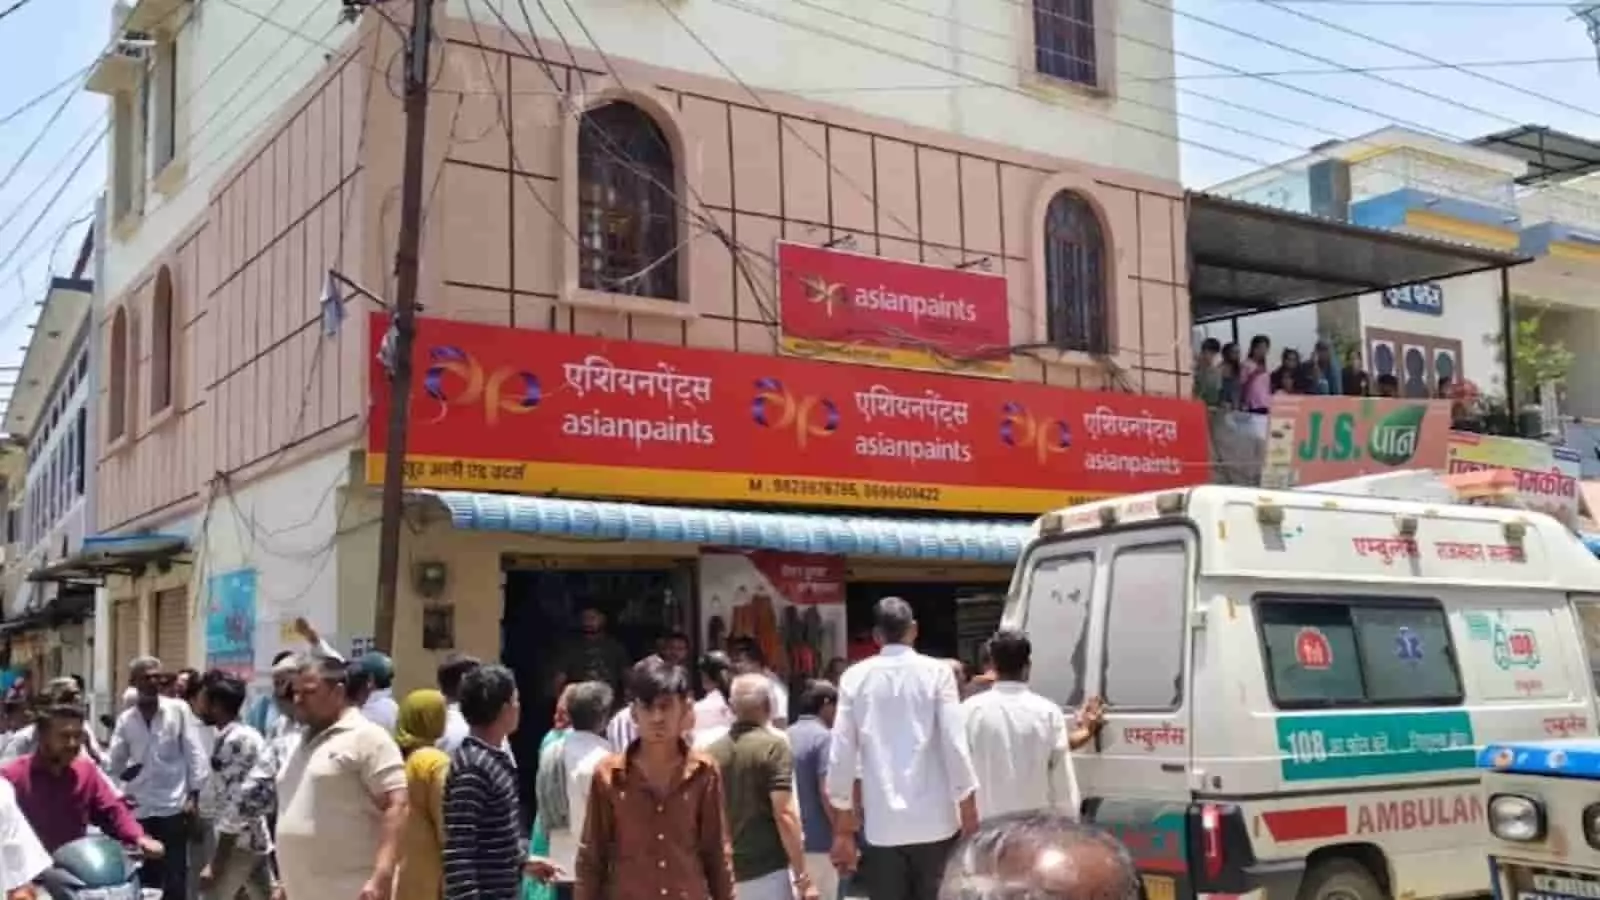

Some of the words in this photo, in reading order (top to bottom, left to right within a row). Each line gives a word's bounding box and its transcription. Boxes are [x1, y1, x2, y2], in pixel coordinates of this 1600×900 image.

[855, 284, 977, 323] asianpaints
[563, 355, 712, 409] एशियनपेंट्स
[855, 385, 969, 431] एशियनपेंट्स
[1083, 407, 1177, 445] एशियनपेंट्स
[563, 410, 714, 448] asianpaints
[1373, 425, 1416, 457] पान
[855, 433, 972, 467] asianpaints
[1084, 452, 1181, 477] asianpaints
[1287, 729, 1327, 764] 108
